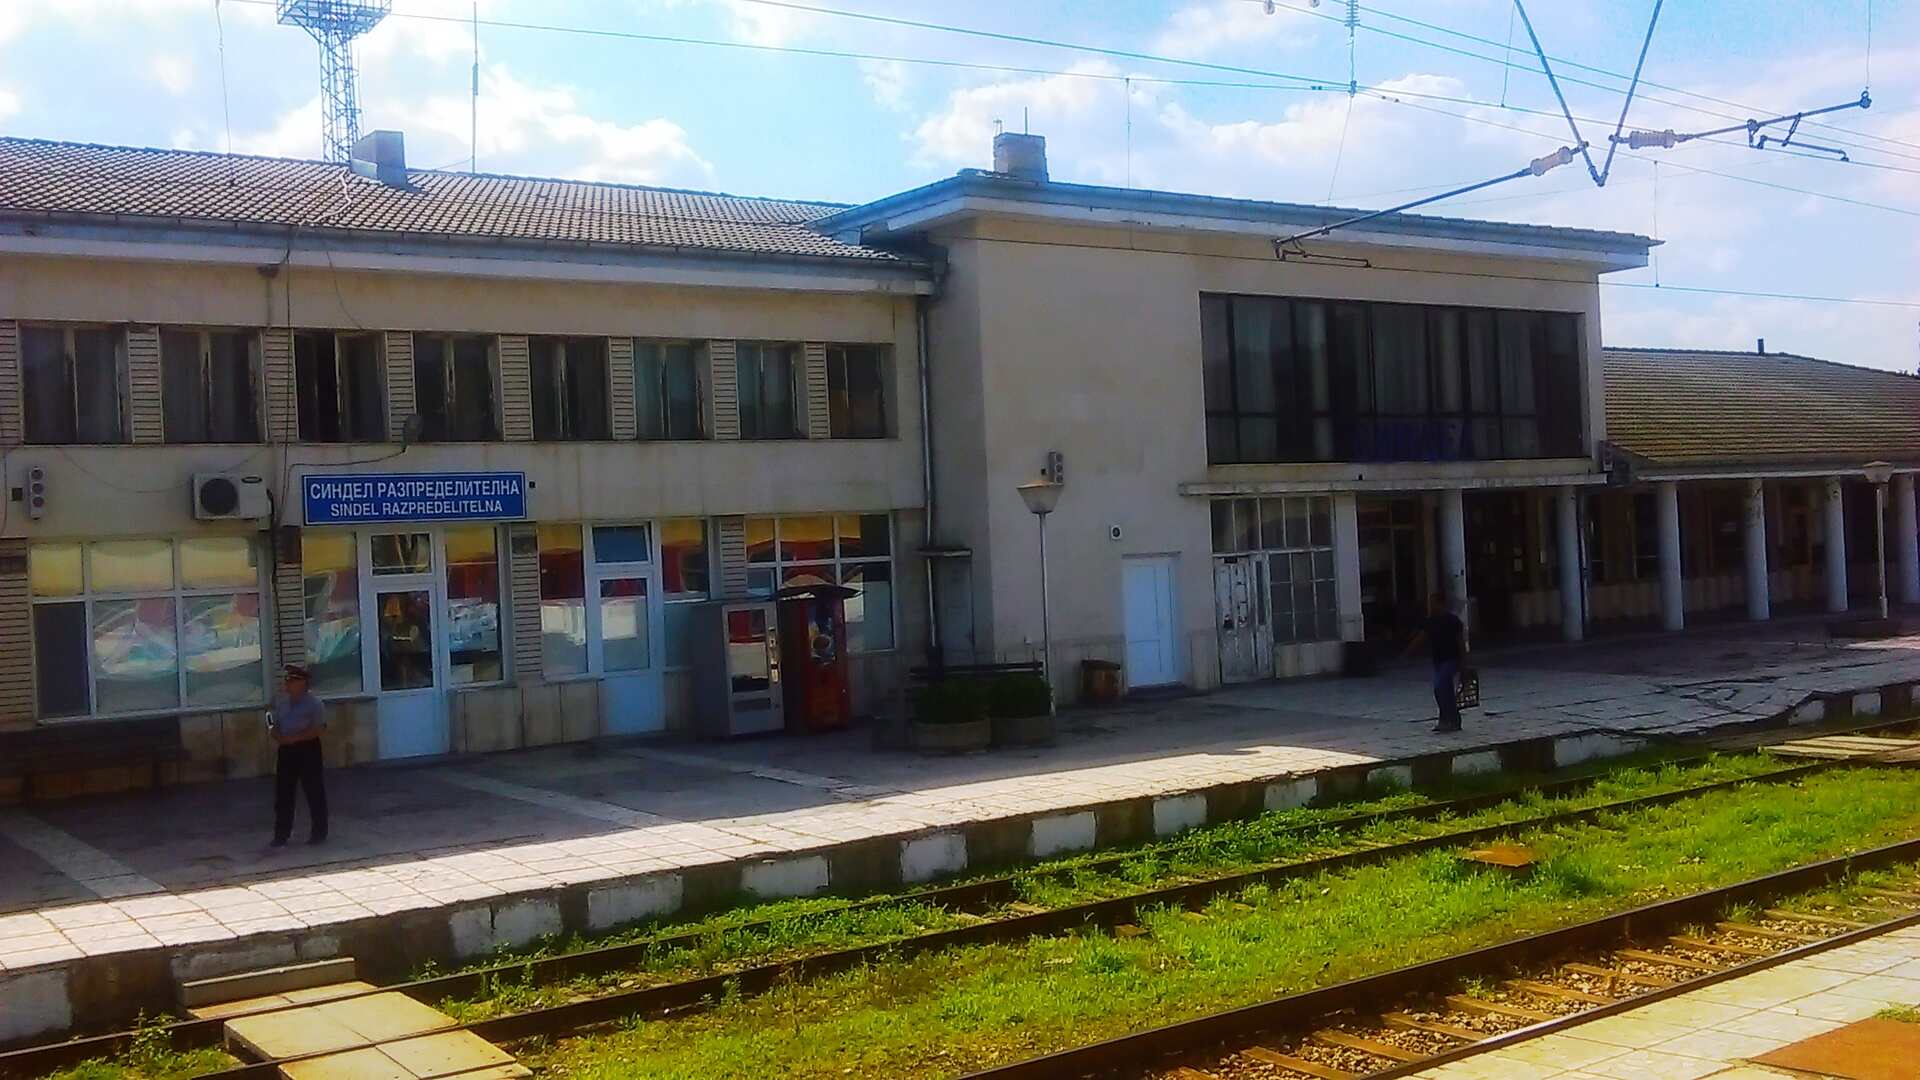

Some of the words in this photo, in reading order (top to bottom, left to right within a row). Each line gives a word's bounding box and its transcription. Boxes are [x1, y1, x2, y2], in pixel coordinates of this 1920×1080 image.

[310, 482, 374, 501] СИНДЕЛ
[377, 480, 520, 499] РАЗПРЕДЕЛИТЕЛНА
[330, 503, 379, 517] SINDEL
[382, 500, 503, 515] RAZPREDELITELNA
